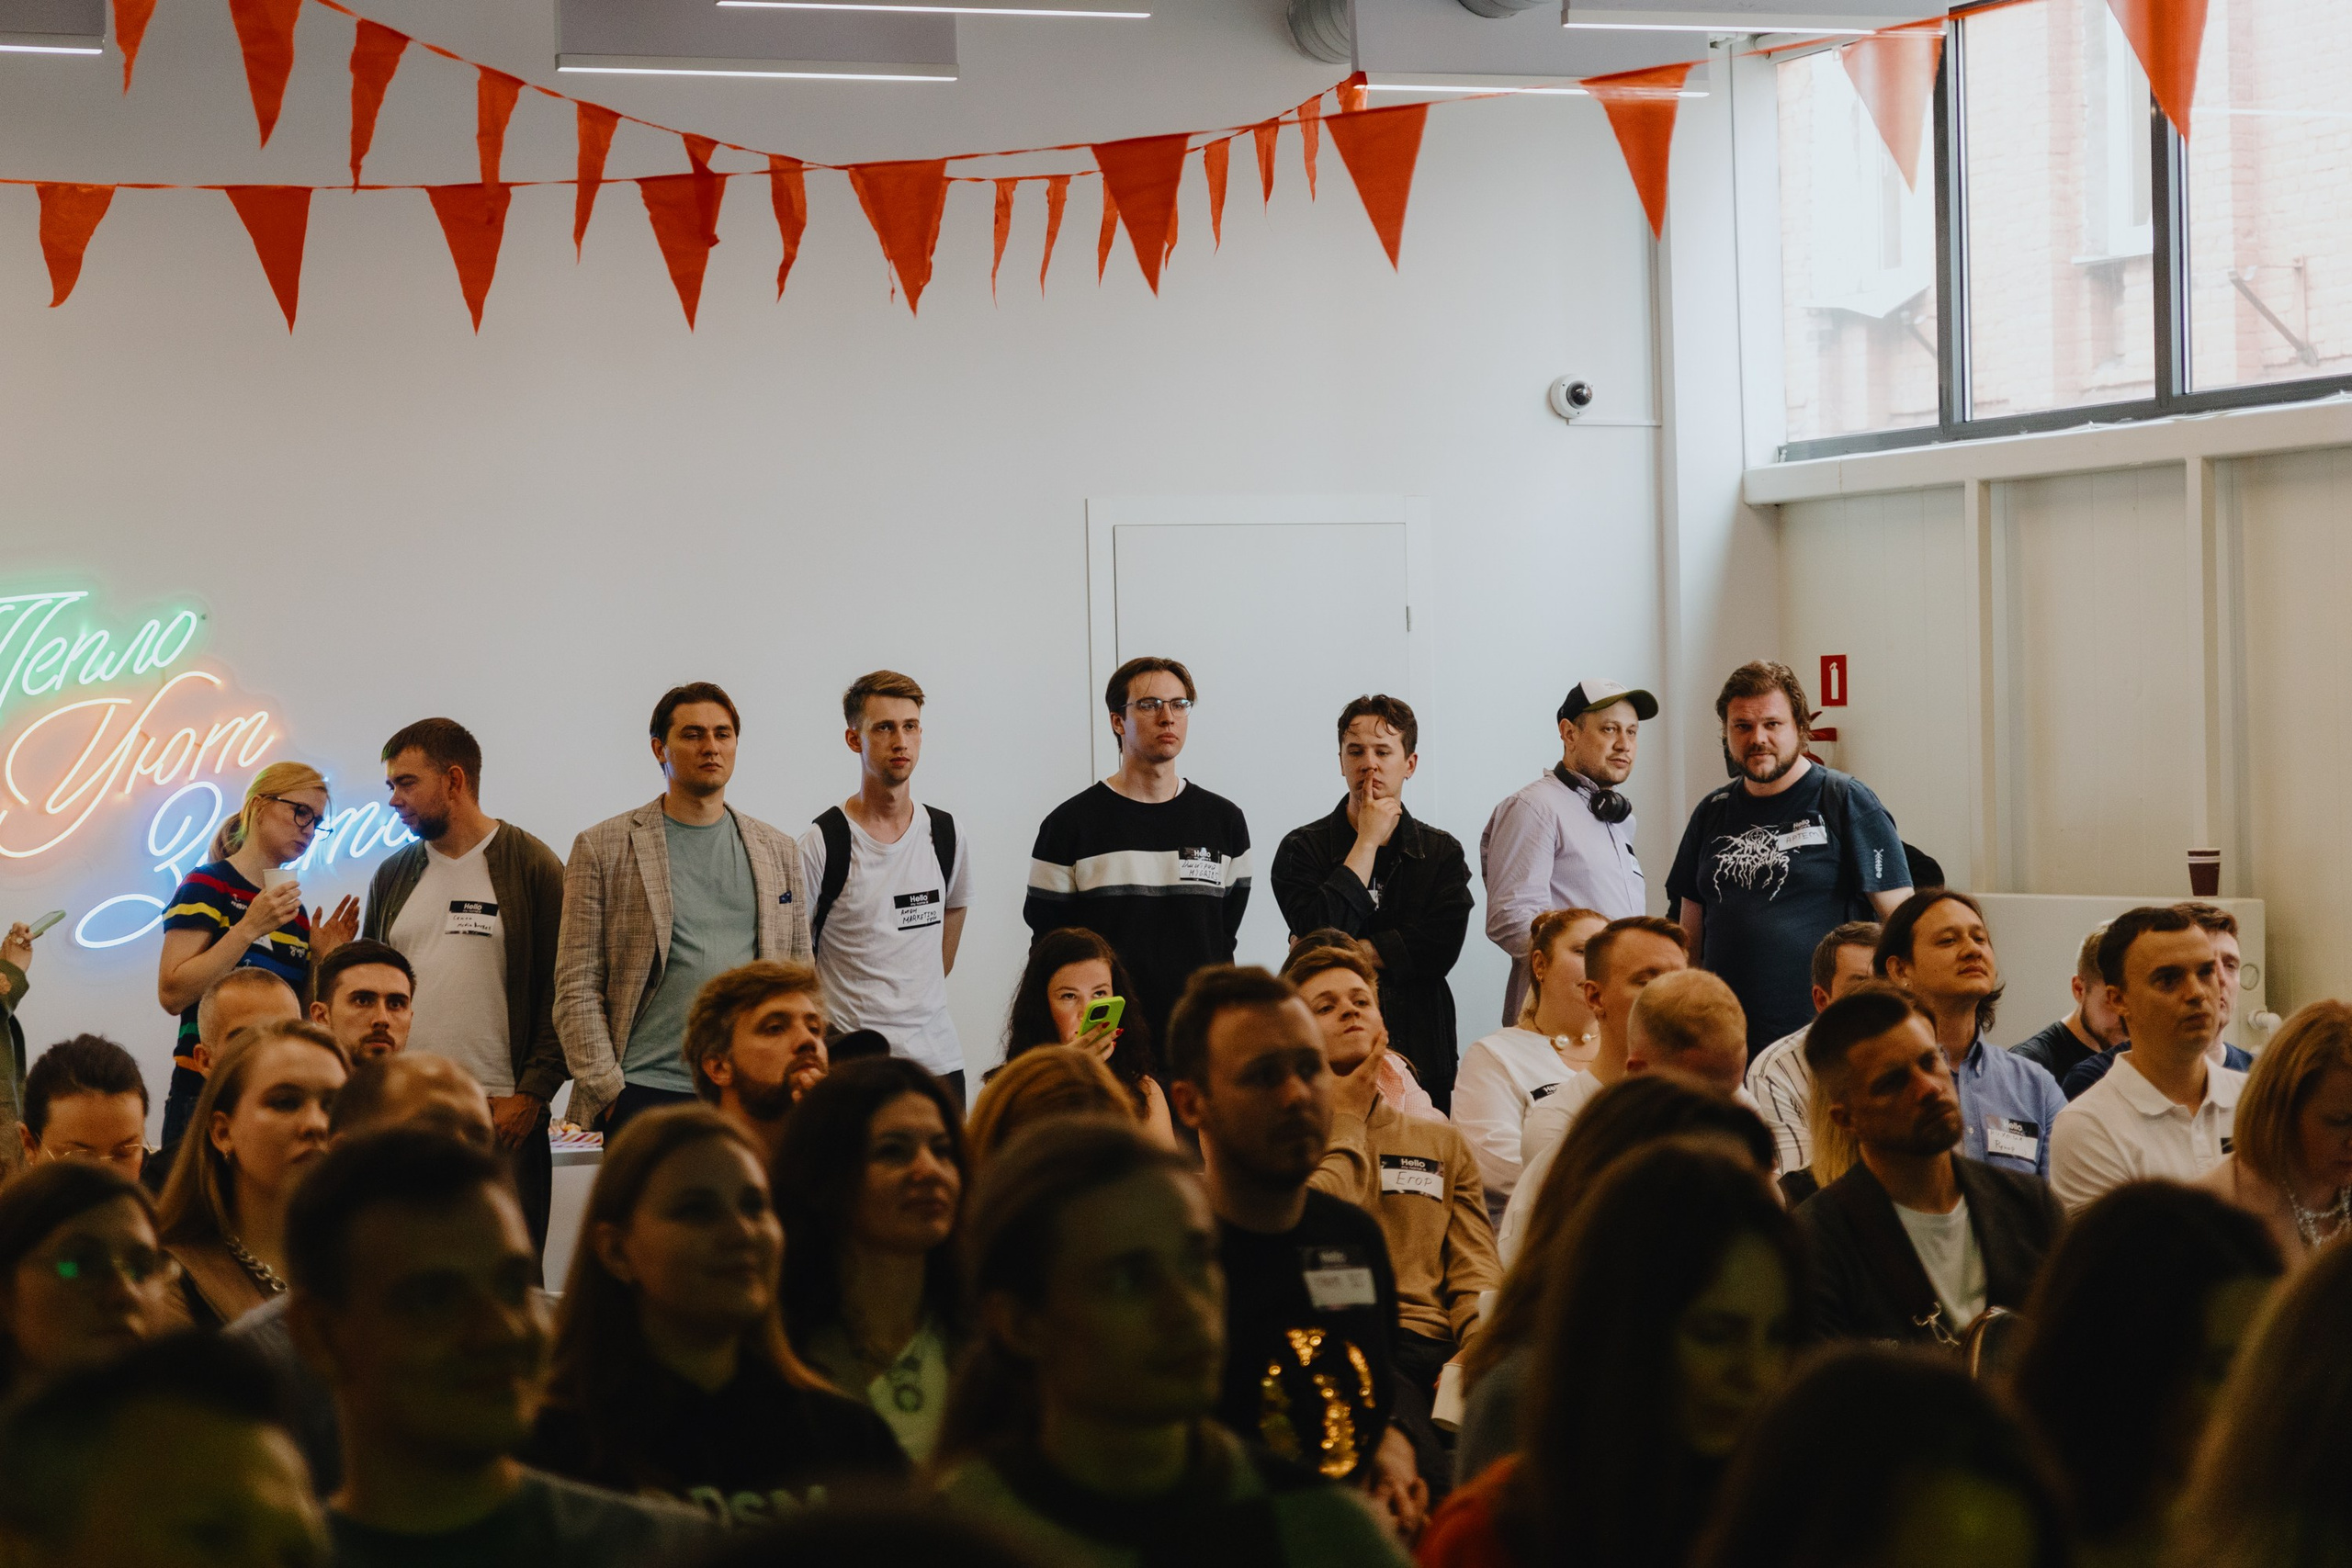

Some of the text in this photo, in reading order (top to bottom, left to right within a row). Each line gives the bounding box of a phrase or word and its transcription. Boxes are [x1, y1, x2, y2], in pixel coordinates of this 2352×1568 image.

[0, 671, 277, 858] Уют
[910, 894, 928, 903] Hello
[1401, 1158, 1426, 1168] Hello
[1396, 1171, 1432, 1187] Егор
